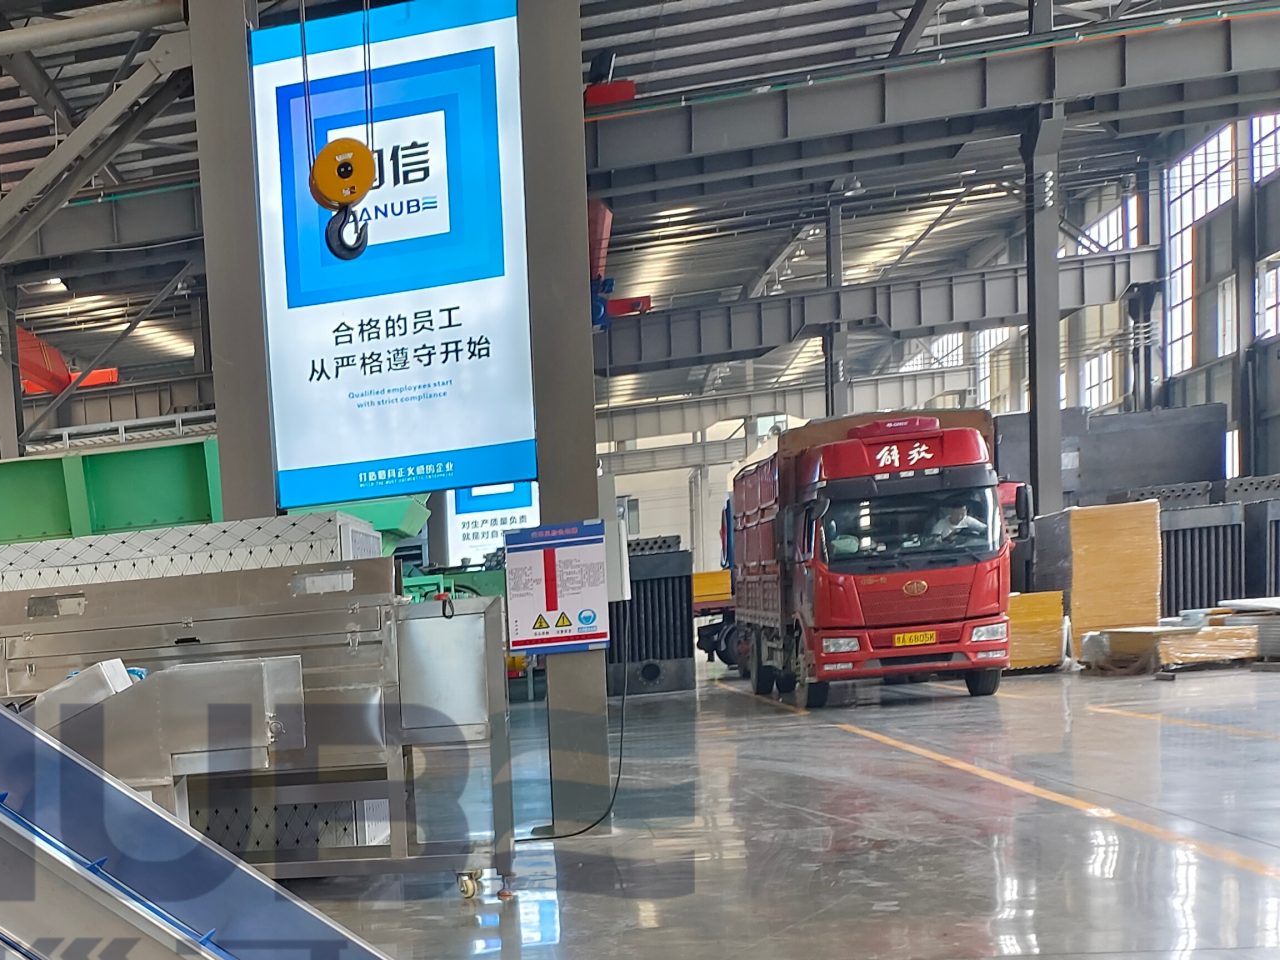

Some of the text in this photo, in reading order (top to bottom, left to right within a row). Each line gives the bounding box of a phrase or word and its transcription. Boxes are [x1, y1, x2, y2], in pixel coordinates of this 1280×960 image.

[350, 195, 438, 223] ANUBE
[332, 306, 462, 346] 合格的员工
[308, 335, 491, 382] 从严格遵守开始
[348, 379, 453, 399] Qualified employees start
[357, 391, 448, 408] with strict compliance
[462, 530, 505, 541] 就是对自
